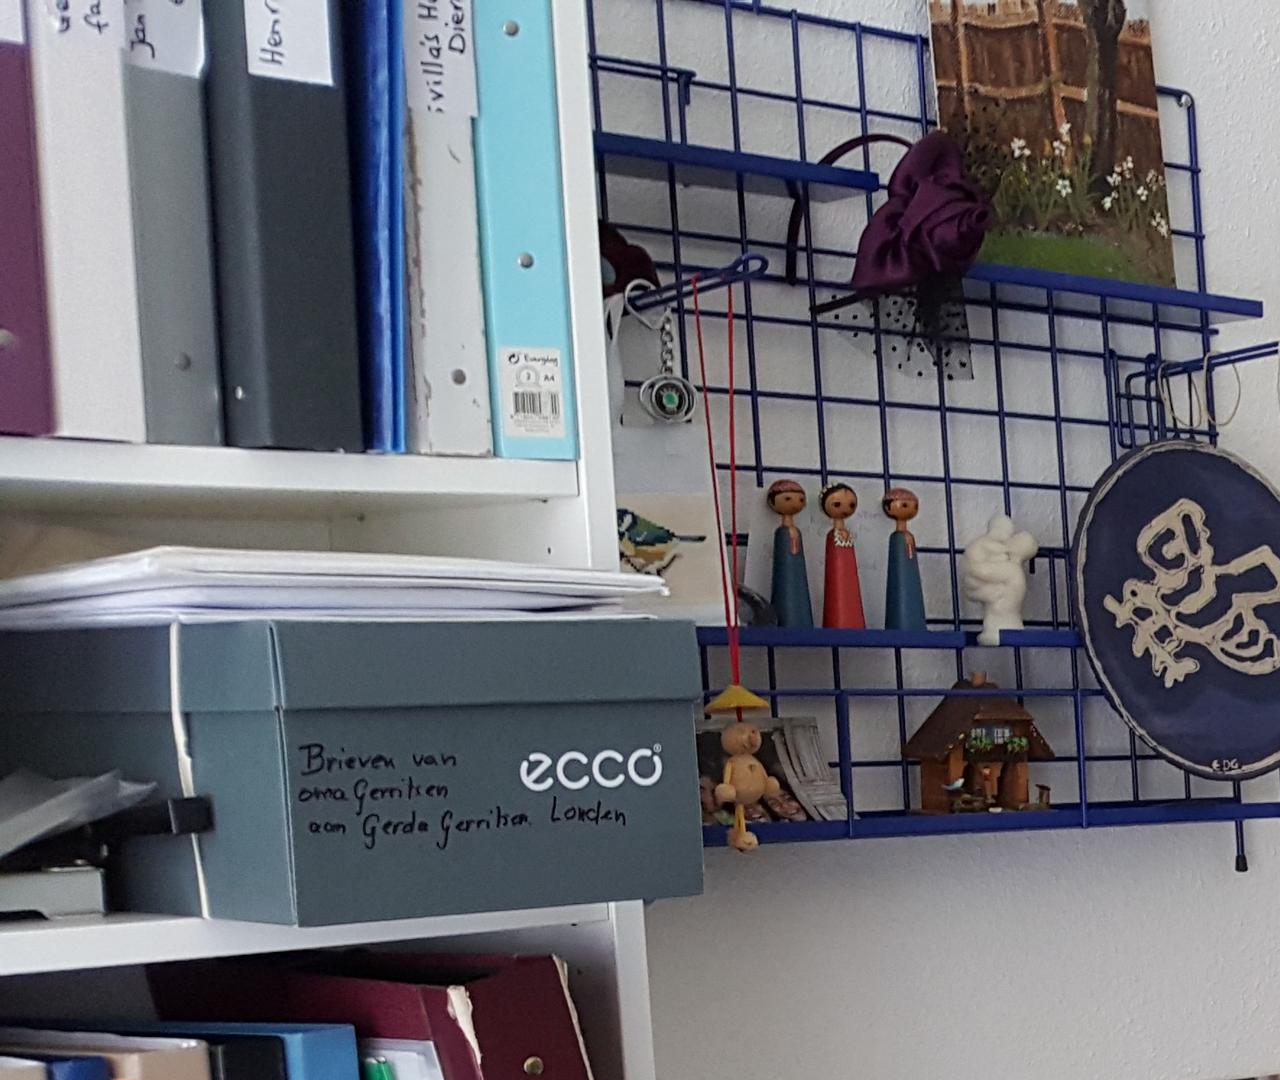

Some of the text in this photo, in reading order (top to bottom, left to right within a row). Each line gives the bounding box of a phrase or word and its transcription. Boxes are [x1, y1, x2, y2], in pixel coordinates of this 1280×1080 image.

[299, 743, 457, 777] Brieven van
[520, 747, 663, 792] ecco
[298, 787, 348, 802] oma
[362, 811, 429, 850] Gerda
